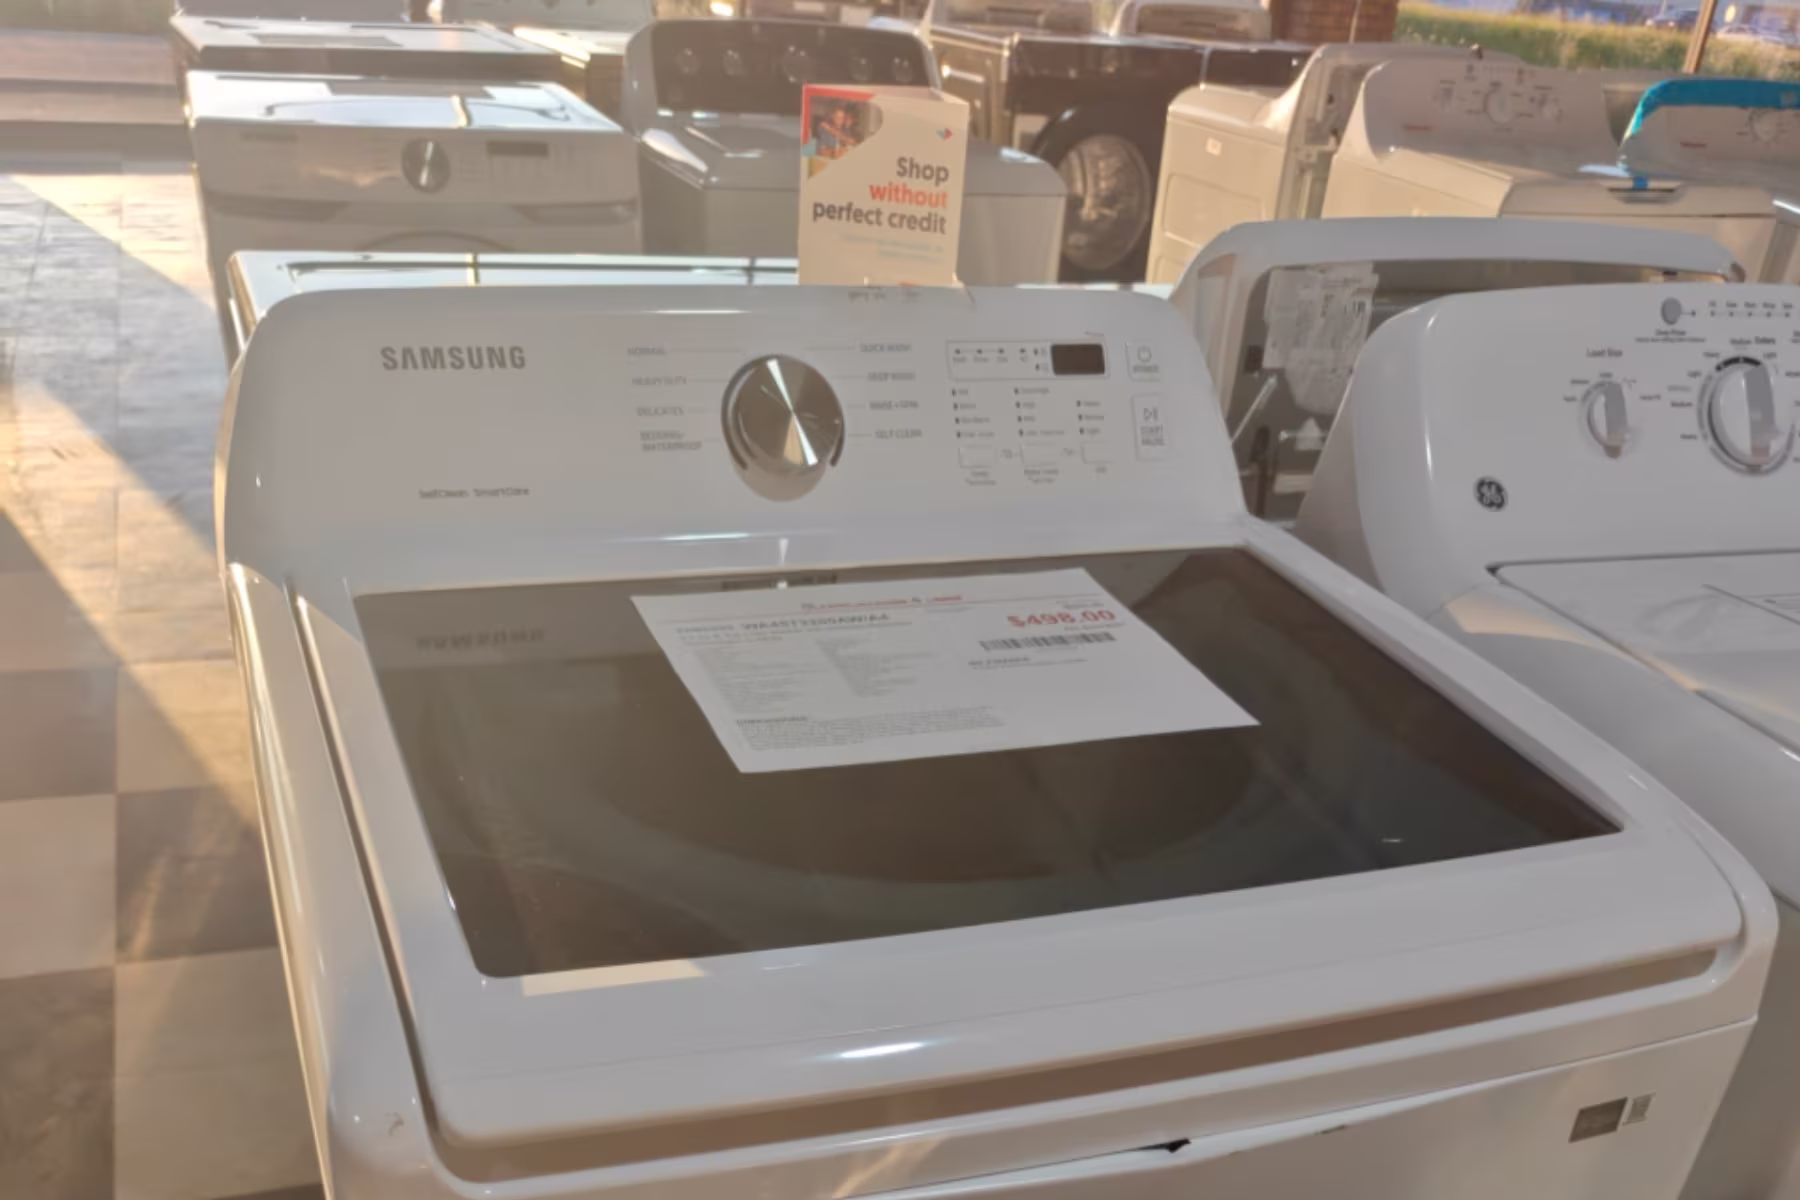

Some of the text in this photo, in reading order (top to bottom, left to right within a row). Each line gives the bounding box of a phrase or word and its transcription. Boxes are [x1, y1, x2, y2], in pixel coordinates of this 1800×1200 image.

[896, 157, 949, 187] Shop
[869, 182, 948, 209] without
[813, 201, 947, 235] perfect credit
[380, 345, 526, 371] SAMSUNG
[1006, 609, 1116, 628] $498.00
